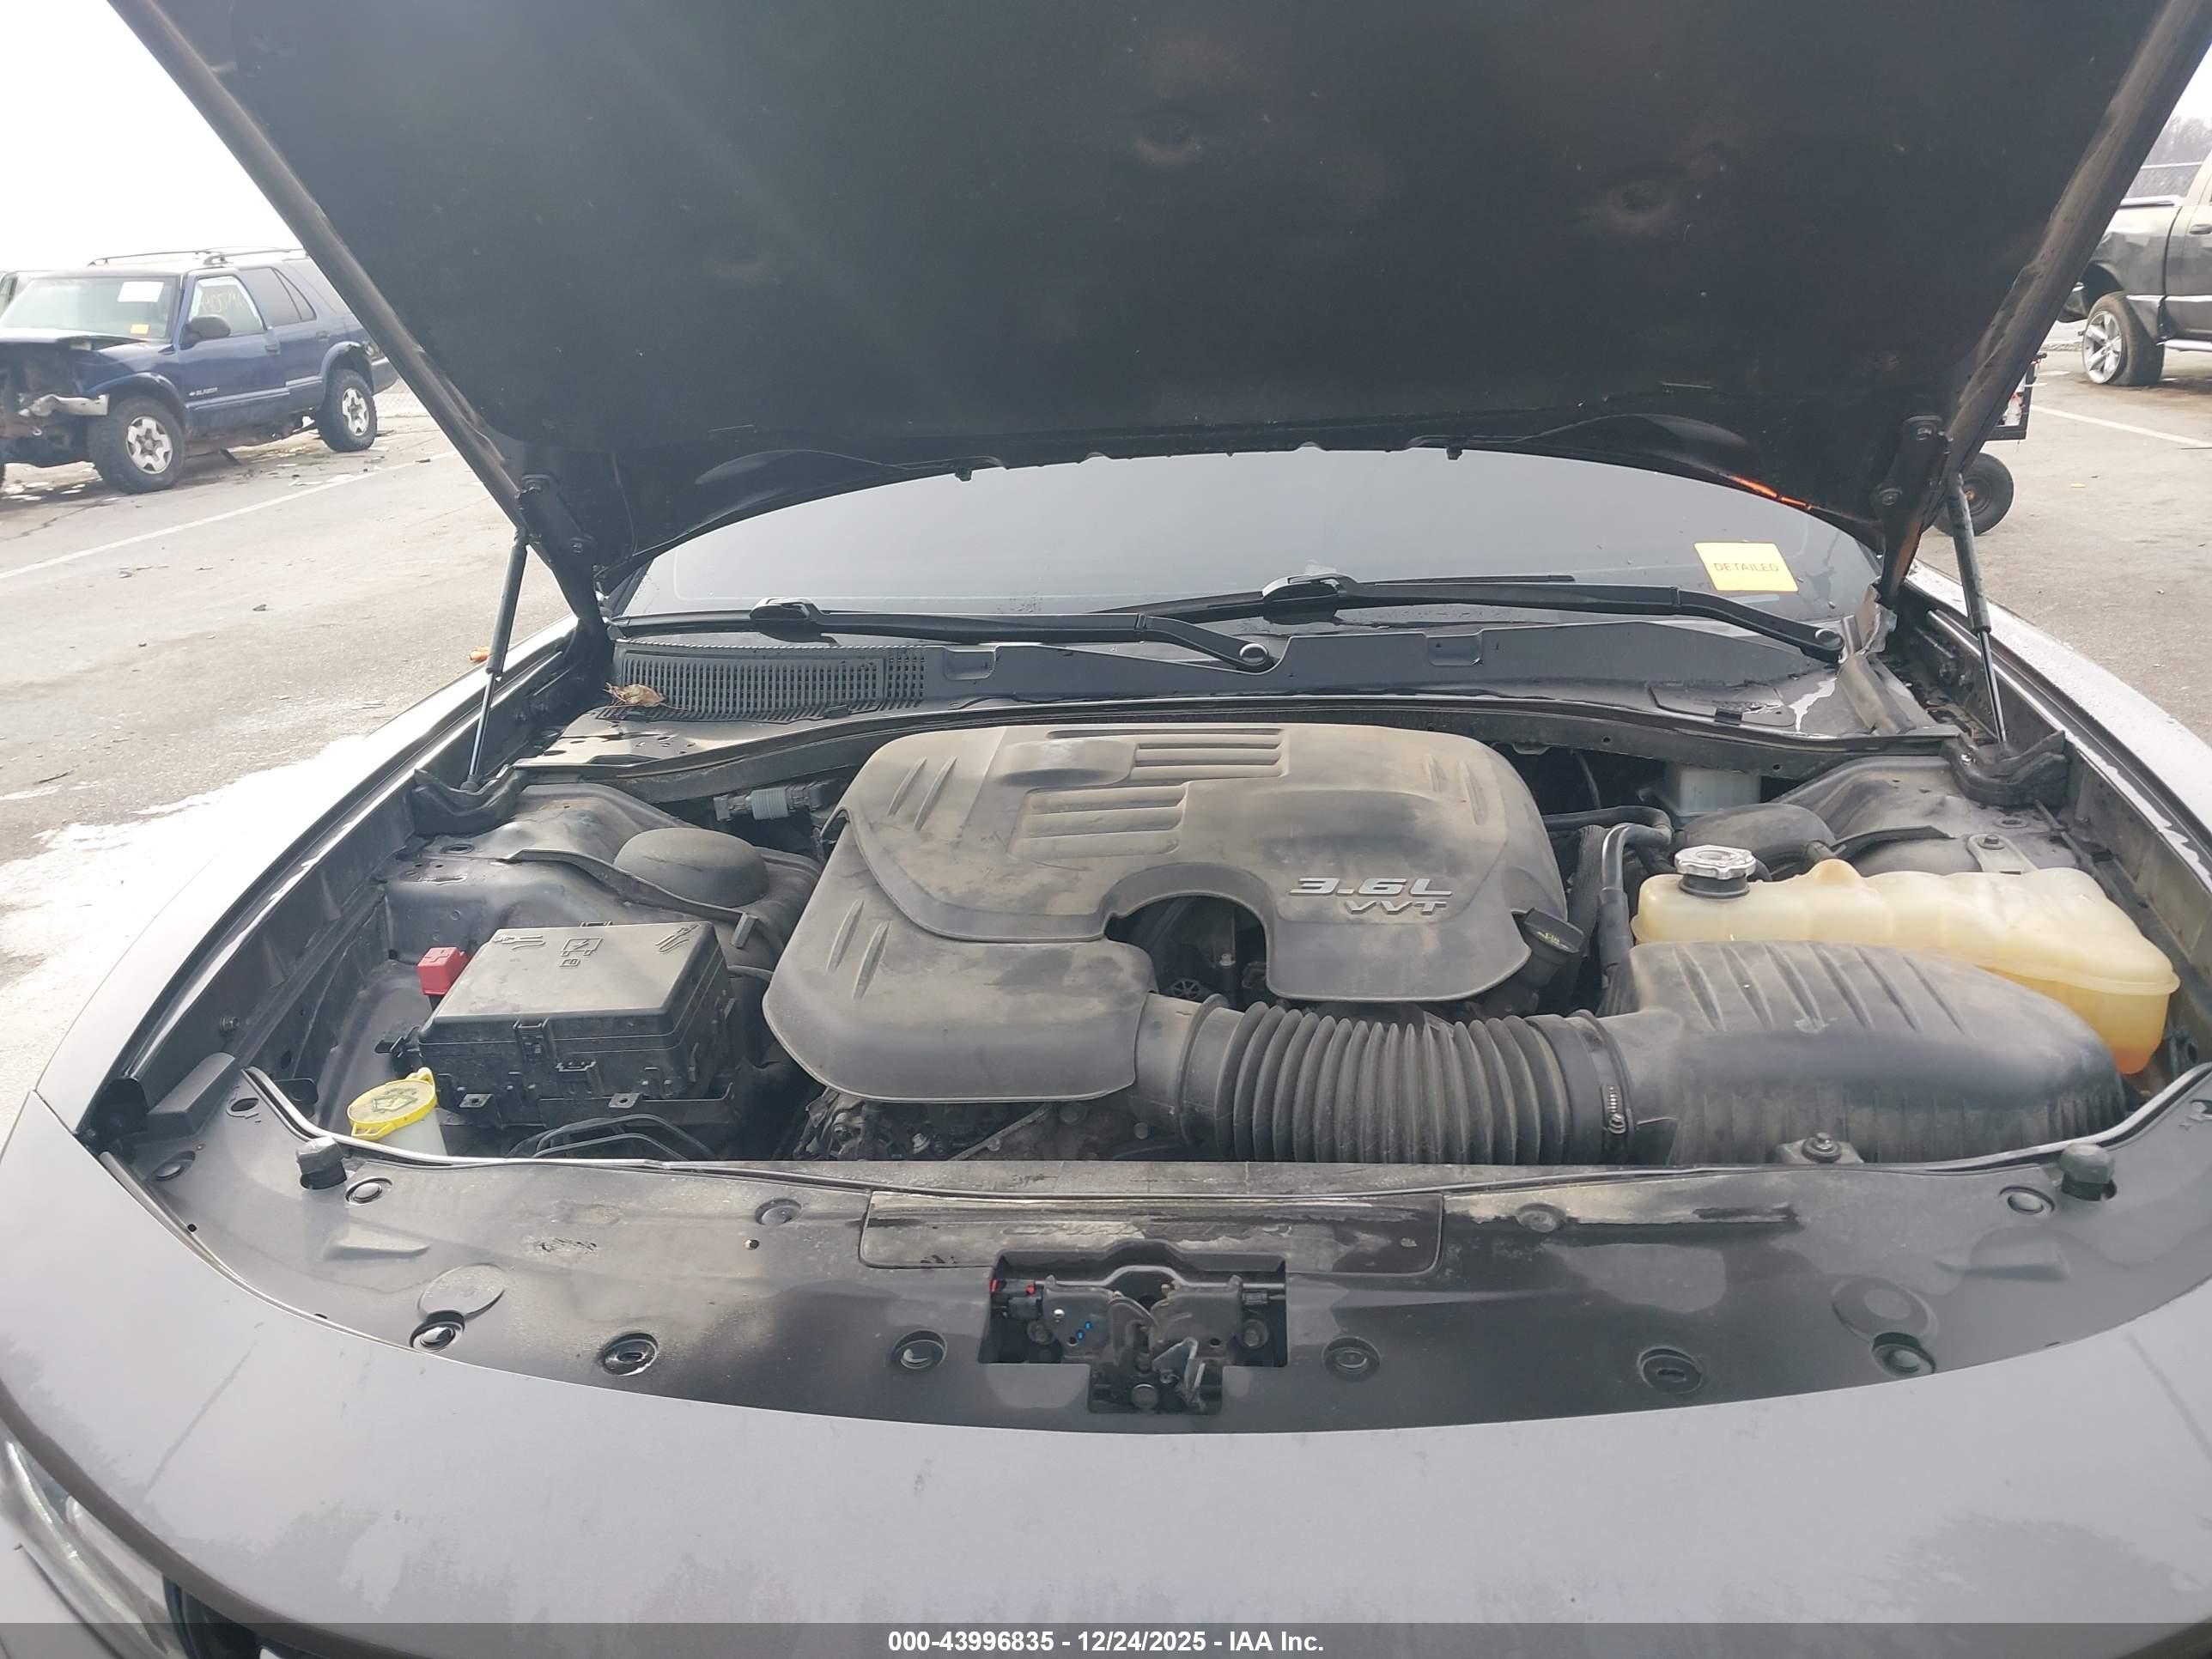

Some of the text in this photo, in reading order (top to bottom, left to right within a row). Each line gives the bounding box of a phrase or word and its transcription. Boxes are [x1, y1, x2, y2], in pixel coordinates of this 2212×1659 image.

[1713, 562, 1779, 573] DETAILED
[1289, 877, 1453, 896] 3.6L
[1344, 900, 1449, 916] VVT
